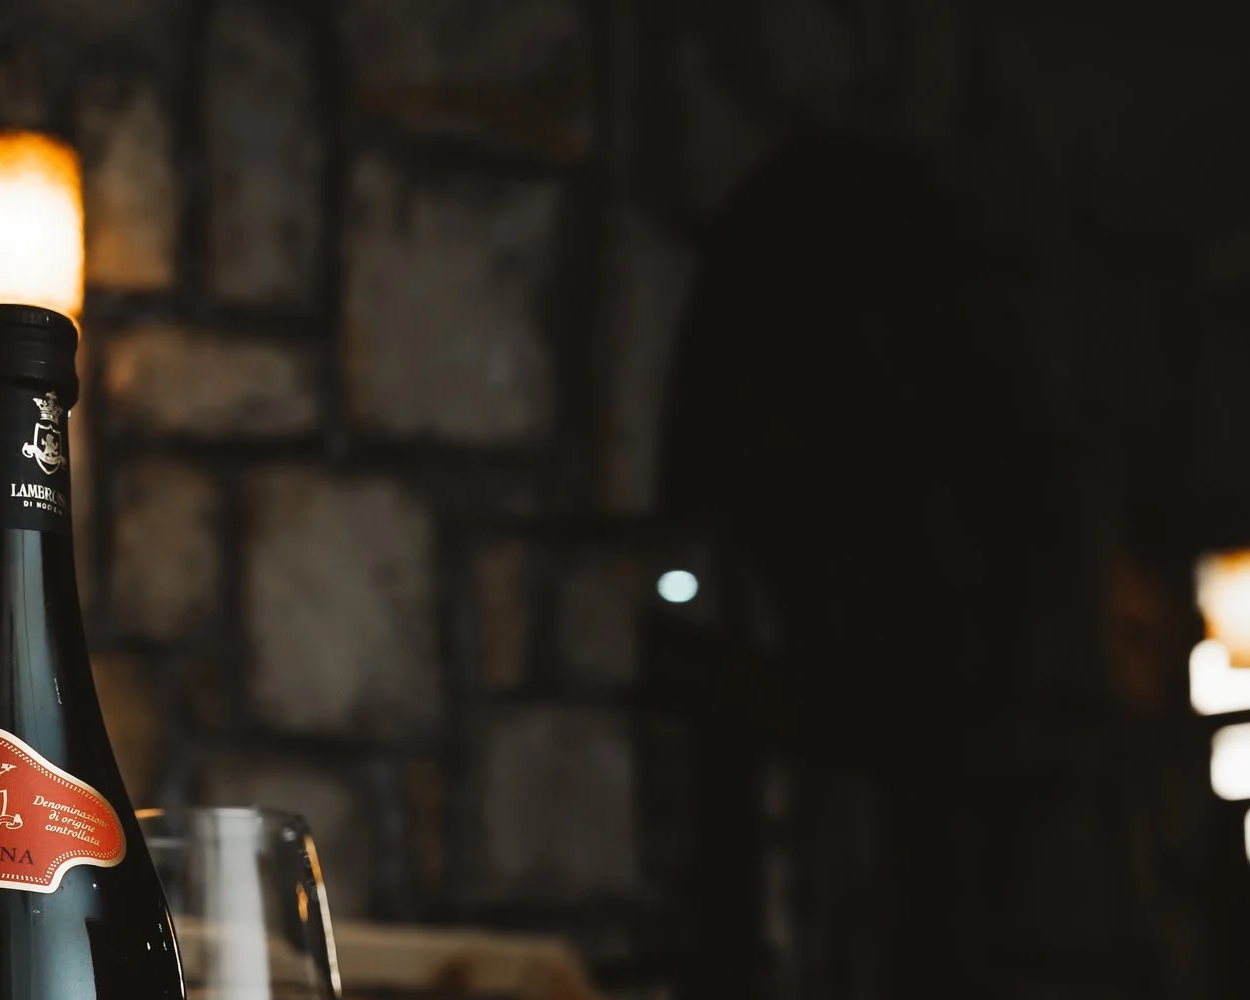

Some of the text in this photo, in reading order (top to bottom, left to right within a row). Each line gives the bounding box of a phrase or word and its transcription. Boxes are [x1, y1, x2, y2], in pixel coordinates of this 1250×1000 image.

[23, 500, 33, 508] DI
[48, 809, 96, 833] di origine
[44, 823, 101, 846] controllata
